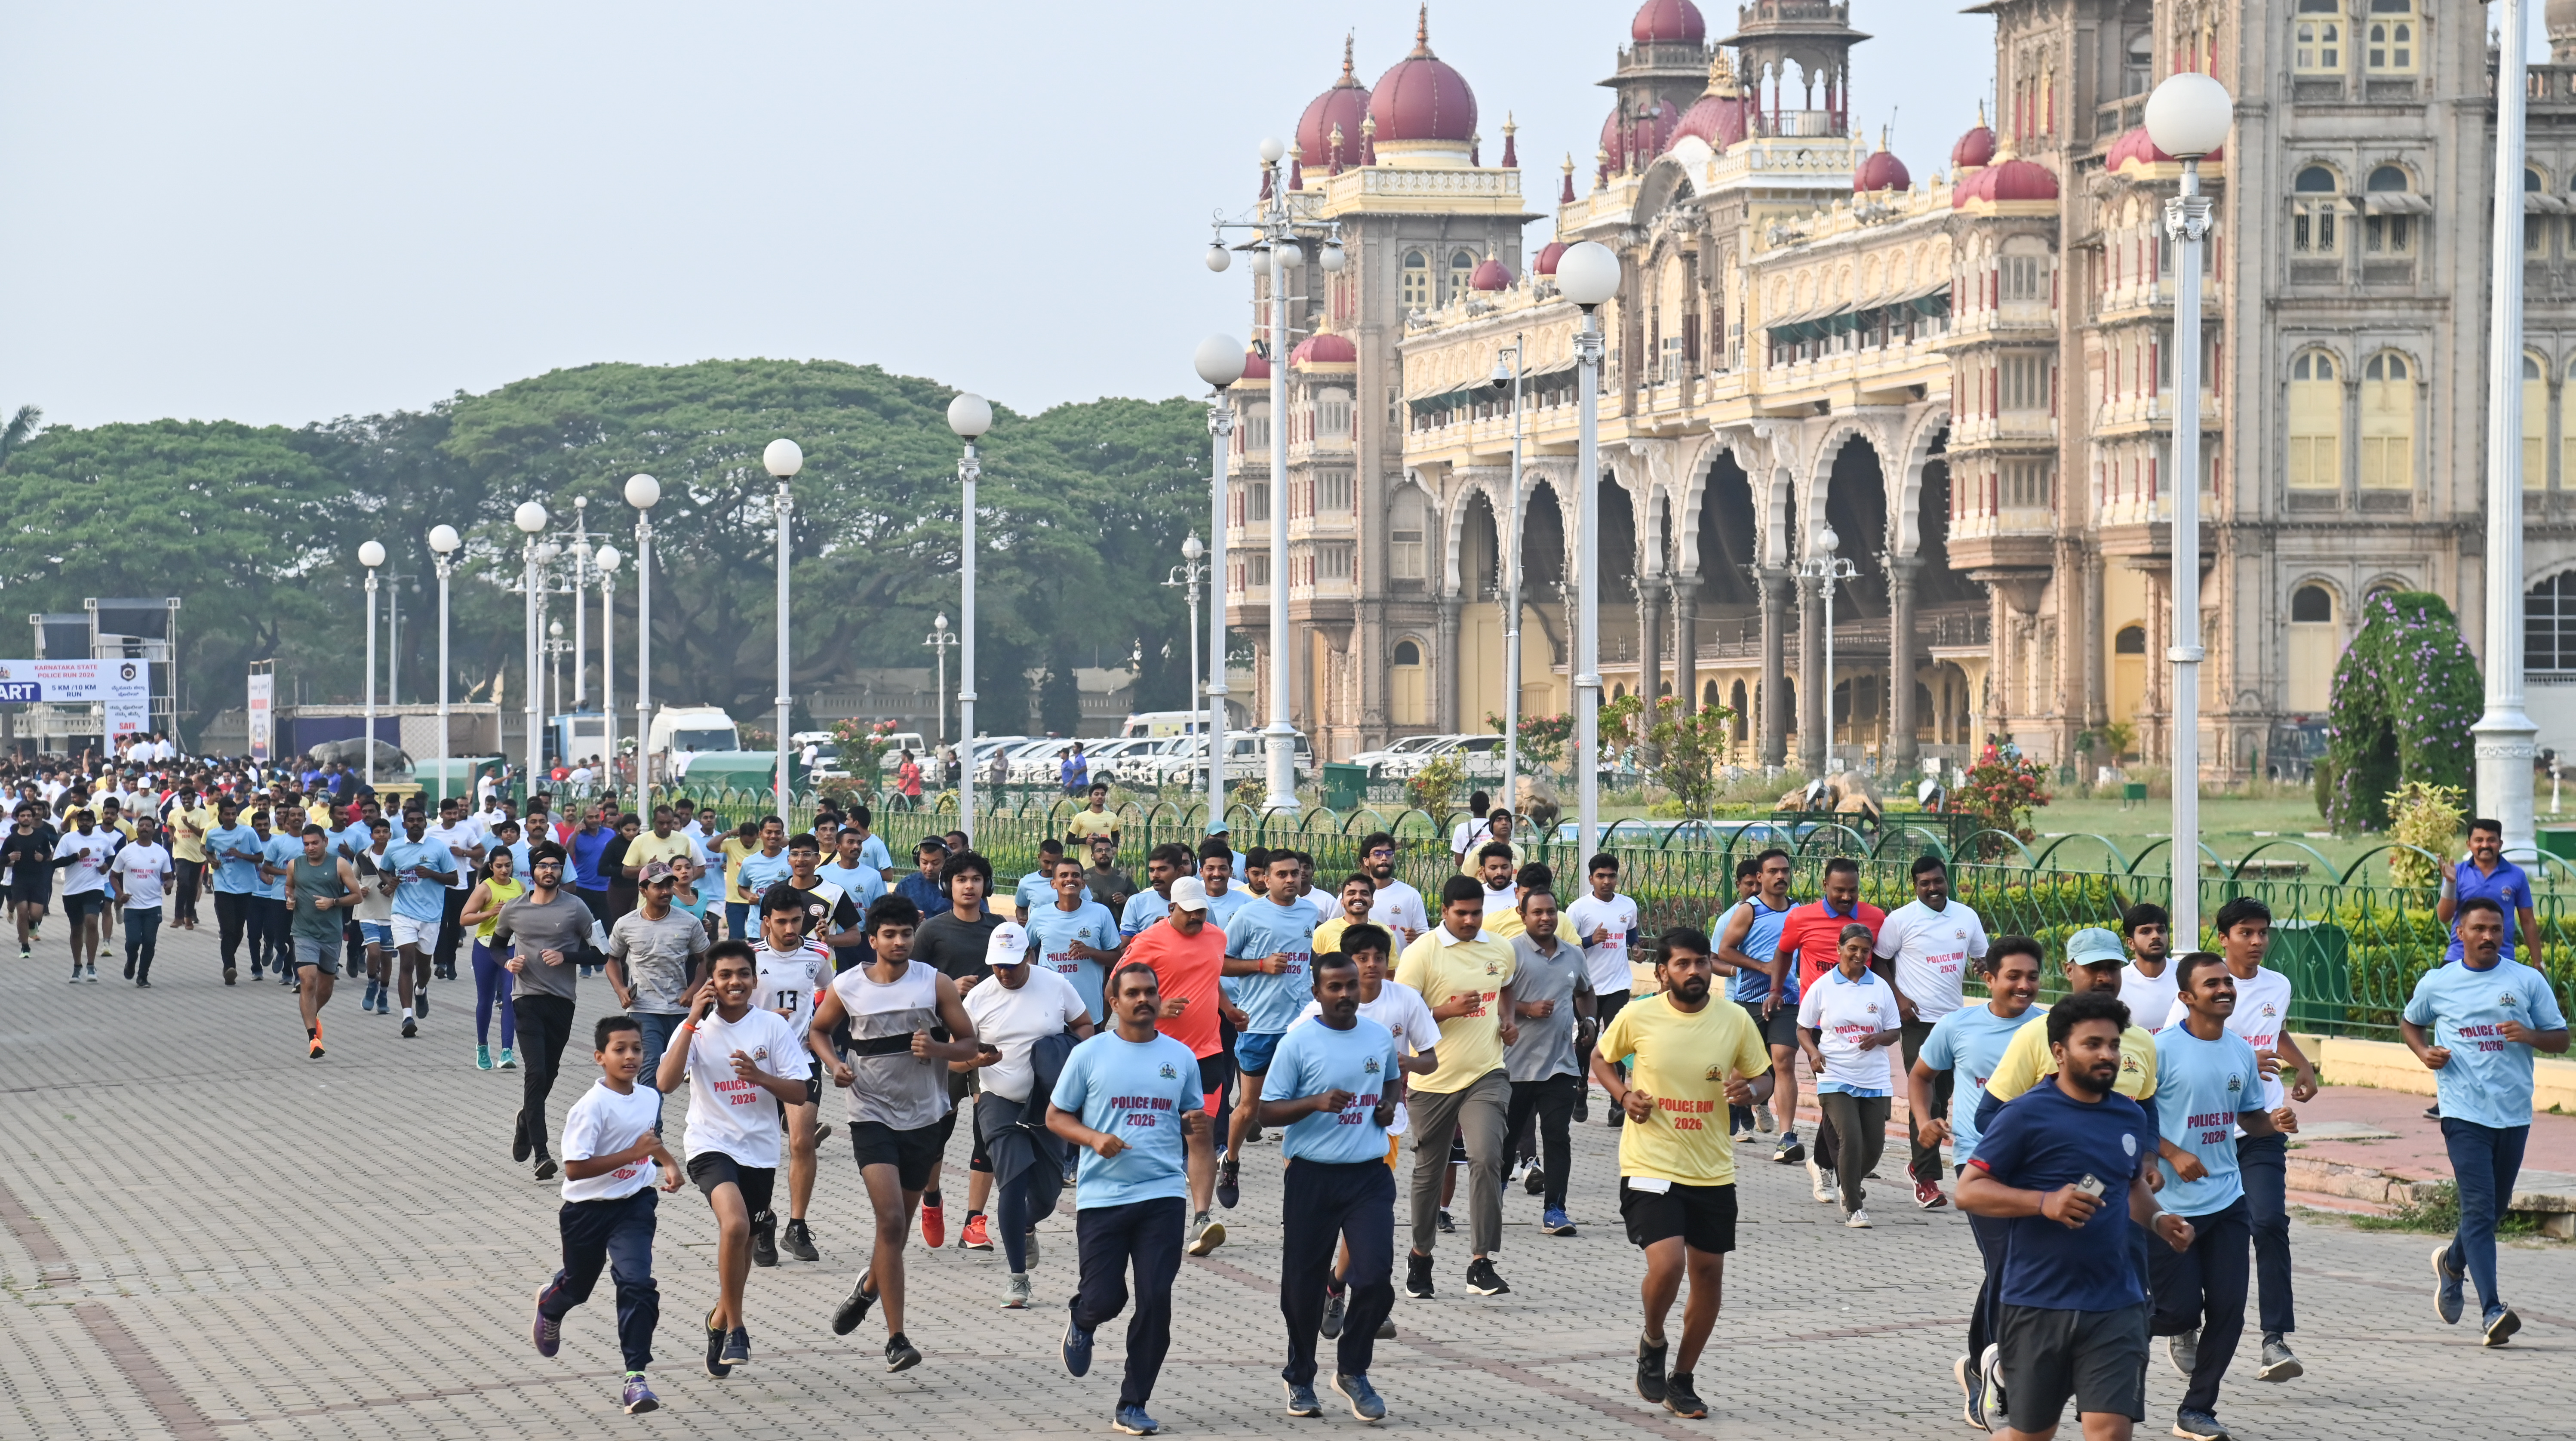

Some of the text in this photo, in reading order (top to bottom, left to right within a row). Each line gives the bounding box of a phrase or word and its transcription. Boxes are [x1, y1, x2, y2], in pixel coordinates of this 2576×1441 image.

[1926, 951, 1964, 964] POLICE RUN
[1057, 964, 1078, 973] 2026
[1940, 964, 1957, 973] 2026
[777, 990, 798, 1012] 13
[1835, 1024, 1874, 1035] POLICE RUN
[2459, 1025, 2494, 1038] POLICE
[2478, 1040, 2504, 1052] 2026
[713, 1079, 747, 1093] POLICE
[730, 1092, 756, 1105] 2026
[1111, 1096, 1173, 1112] POLICE RUN
[1359, 1093, 1379, 1107] RUN
[1659, 1097, 1714, 1113] POLICE RUN
[1126, 1114, 1156, 1127] 2026
[1337, 1112, 1362, 1125] 2026
[1675, 1117, 1703, 1130] 2026
[2187, 1112, 2221, 1129] POLICE
[2201, 1130, 2227, 1145] 2026
[755, 1210, 765, 1222] 18
